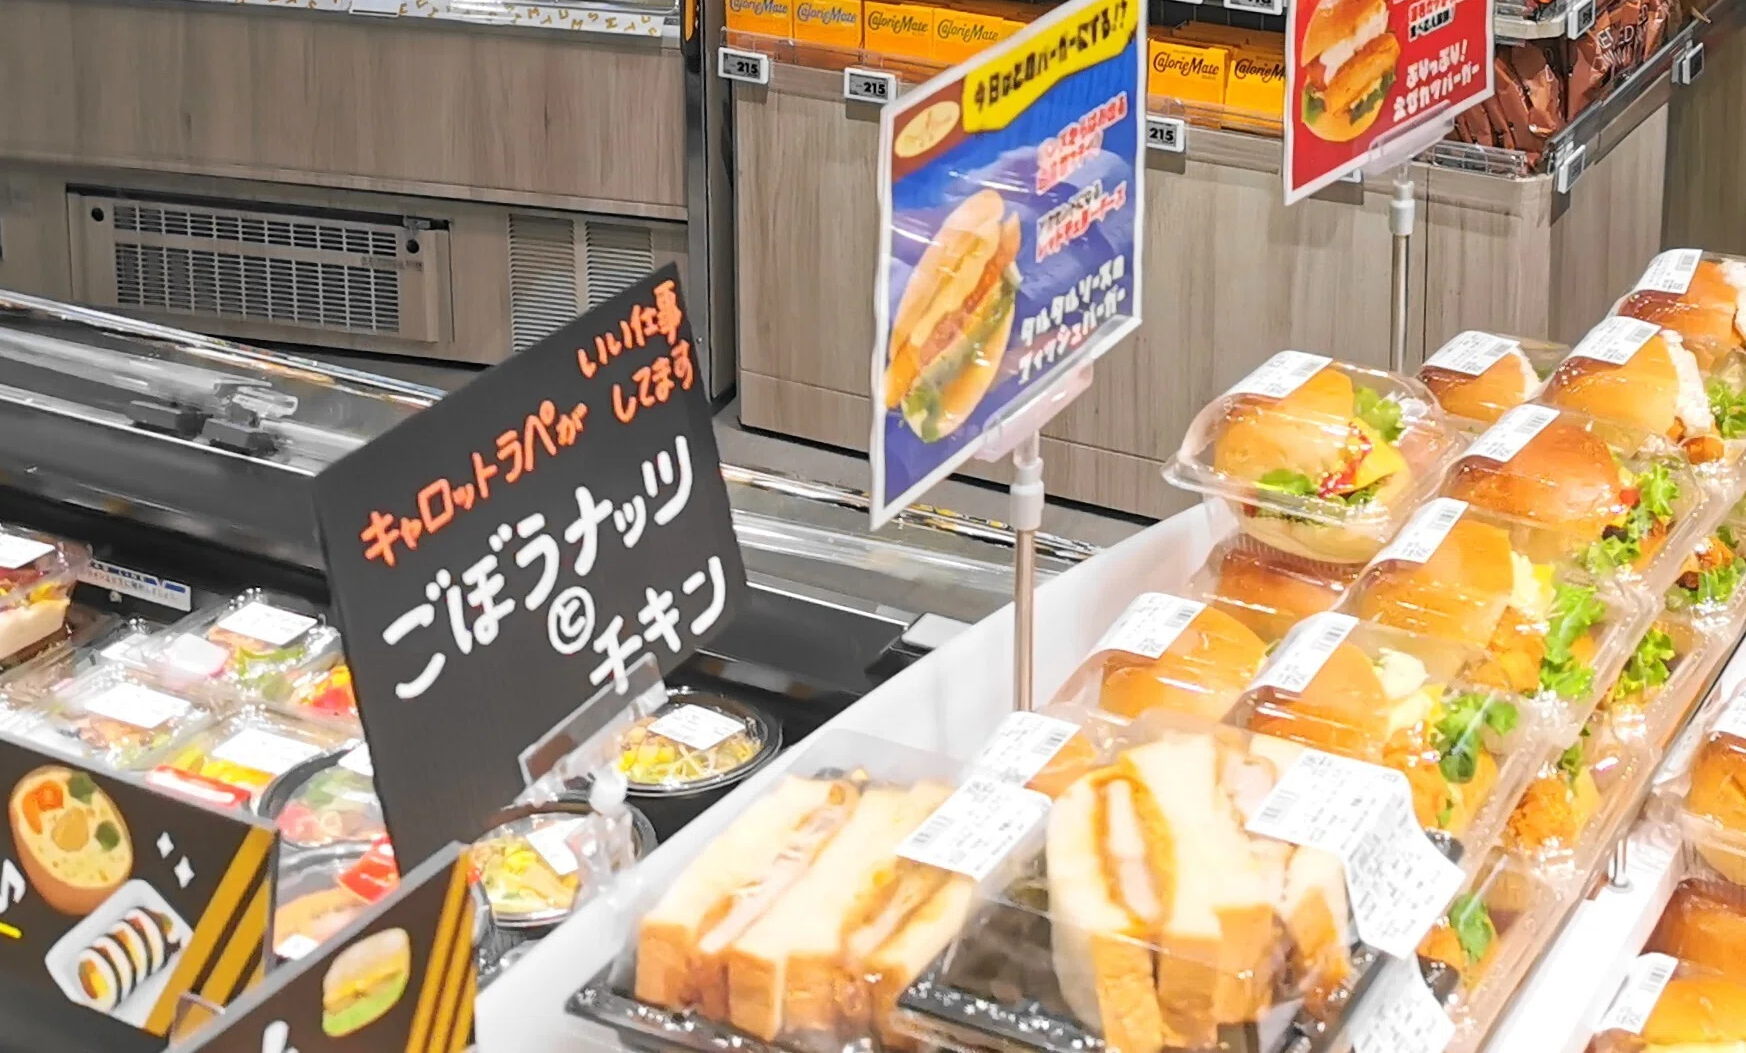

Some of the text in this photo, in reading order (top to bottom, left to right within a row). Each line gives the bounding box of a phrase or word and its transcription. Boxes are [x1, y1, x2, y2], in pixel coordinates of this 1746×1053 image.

[797, 2, 857, 24] CalorieMate
[867, 10, 929, 33] CalorieMate
[937, 19, 999, 43] CalorieMate
[737, 62, 758, 74] 215
[1153, 52, 1220, 76] CalorieMate
[863, 81, 886, 95] 215
[1149, 127, 1174, 141] 215
[1020, 255, 1125, 346] タルタルソースの
[577, 279, 683, 378] いい仕事
[610, 339, 695, 424] してます
[359, 399, 589, 567] キャロットラペが
[588, 555, 726, 696] チキン
